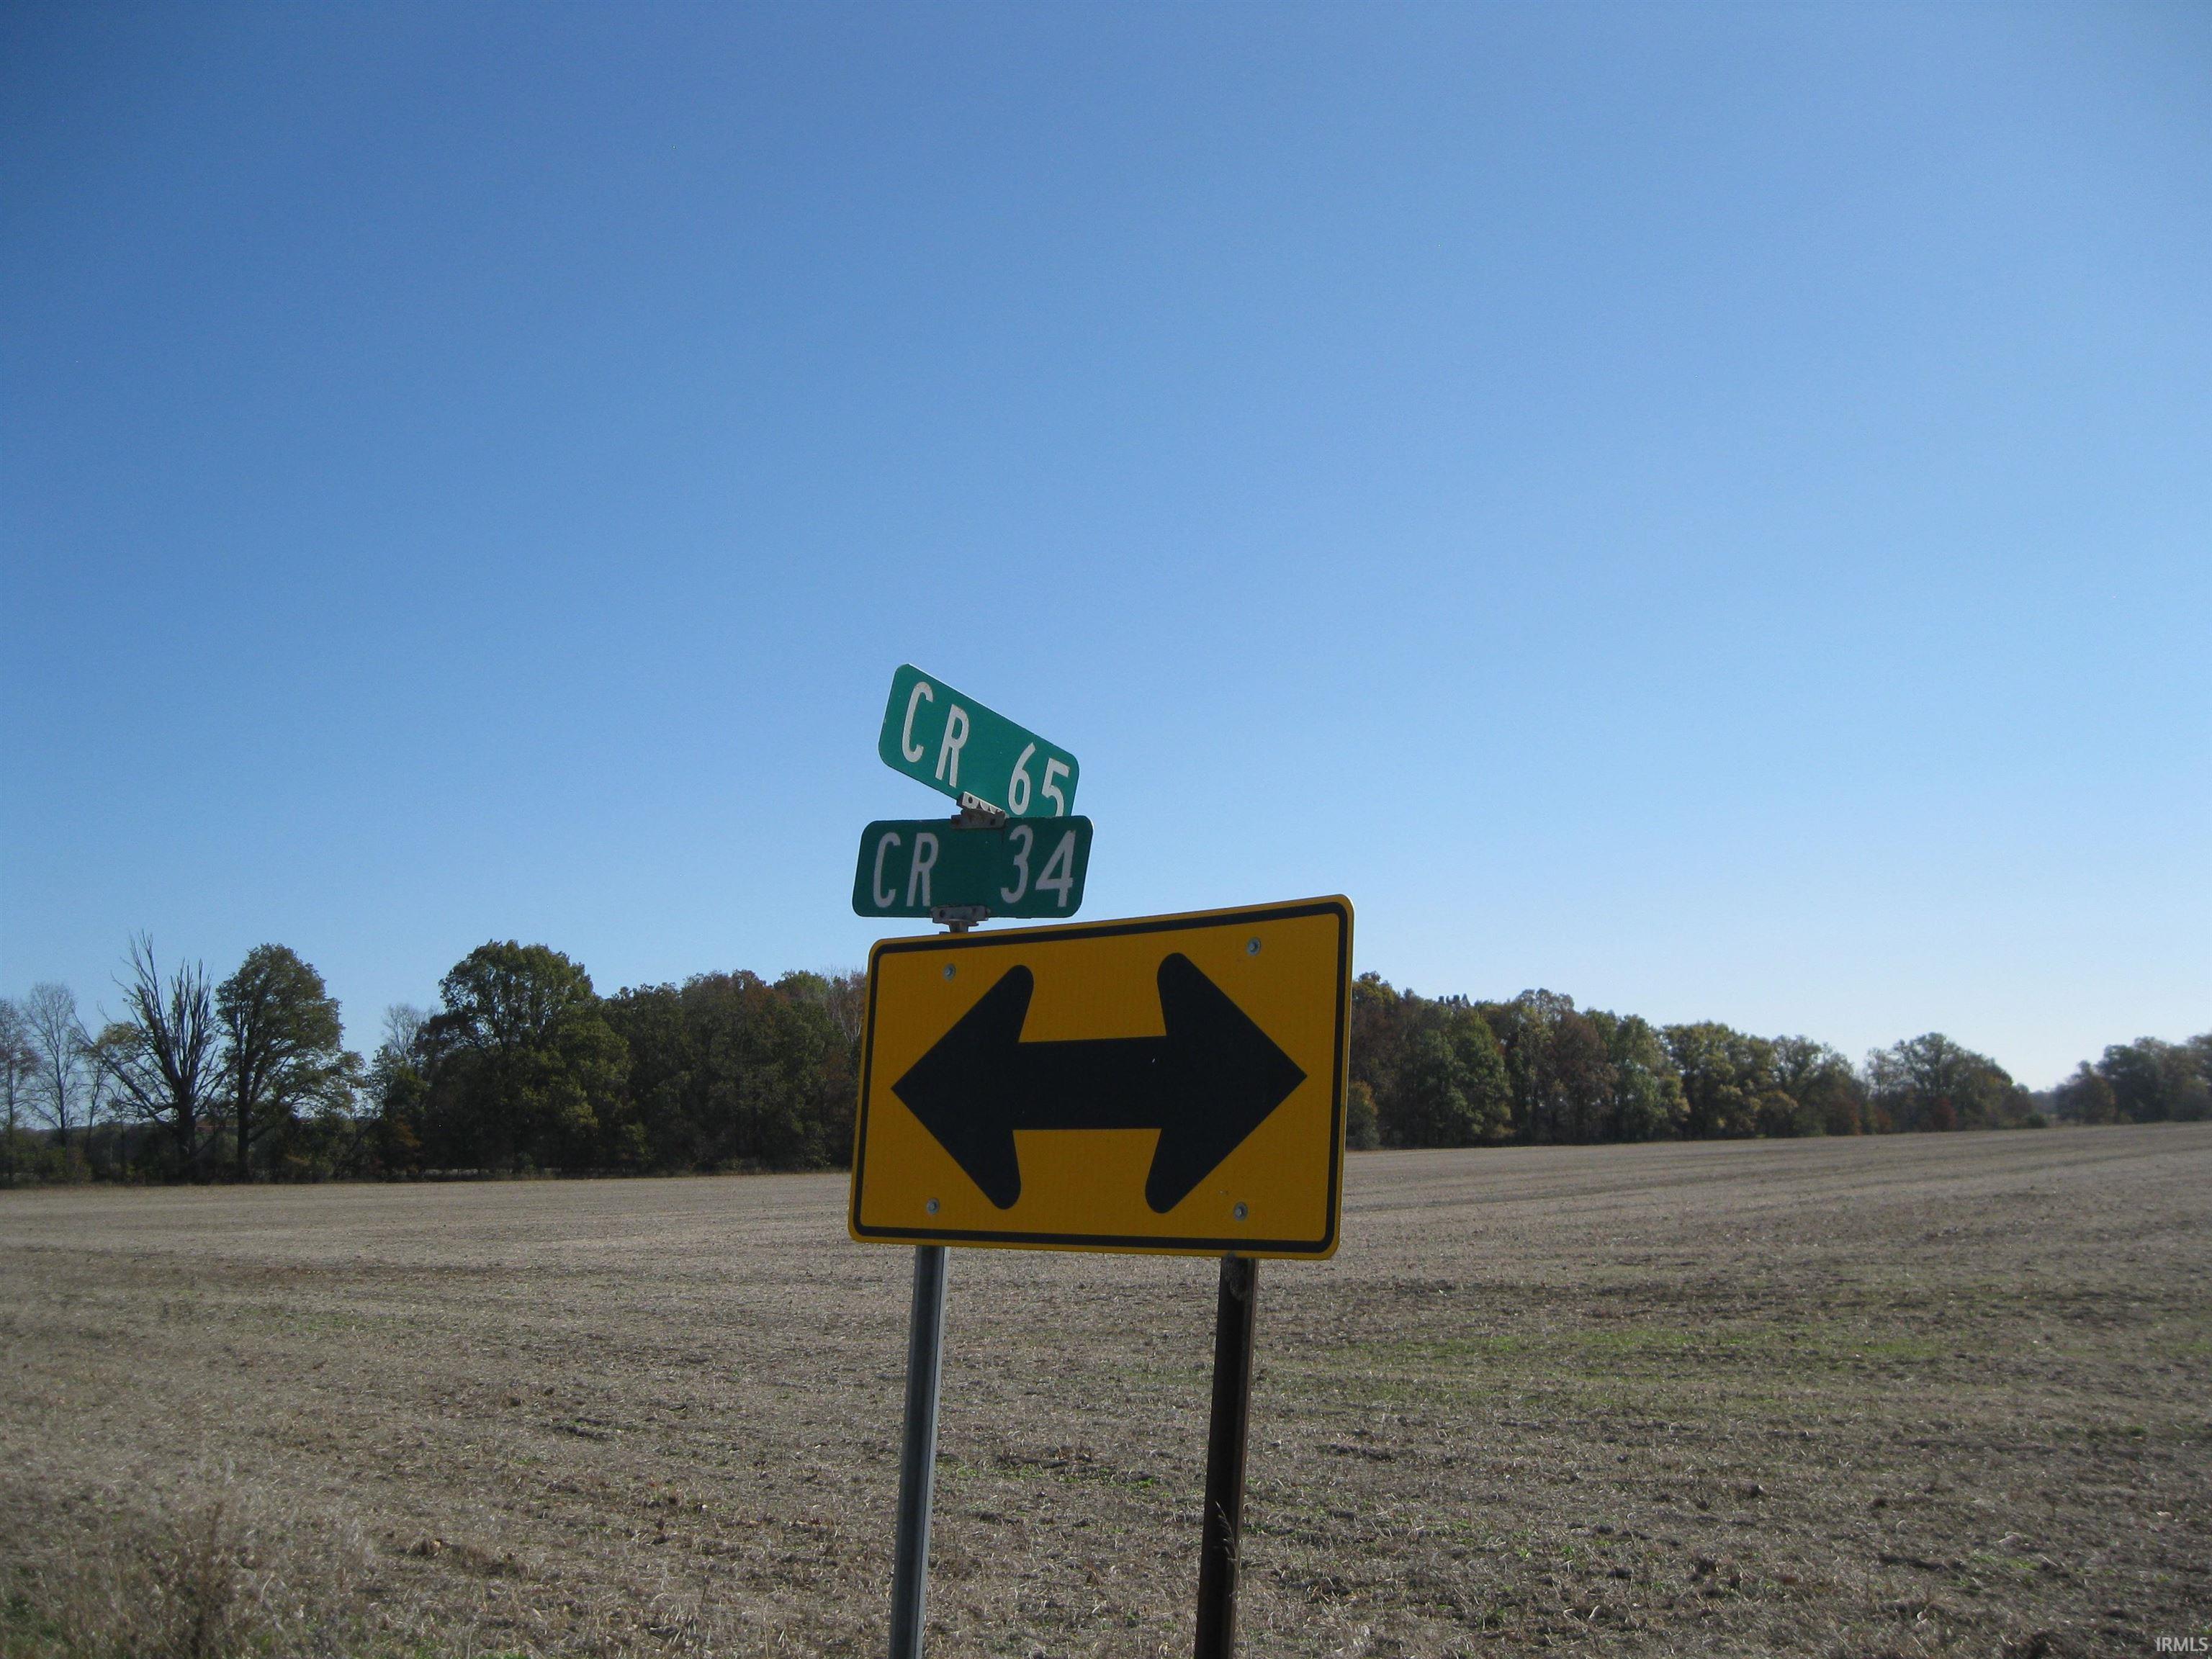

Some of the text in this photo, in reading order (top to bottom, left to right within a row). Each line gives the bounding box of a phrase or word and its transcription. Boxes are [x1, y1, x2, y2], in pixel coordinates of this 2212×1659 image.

[902, 681, 1070, 817] CR 65
[873, 824, 1076, 908] CR 34
